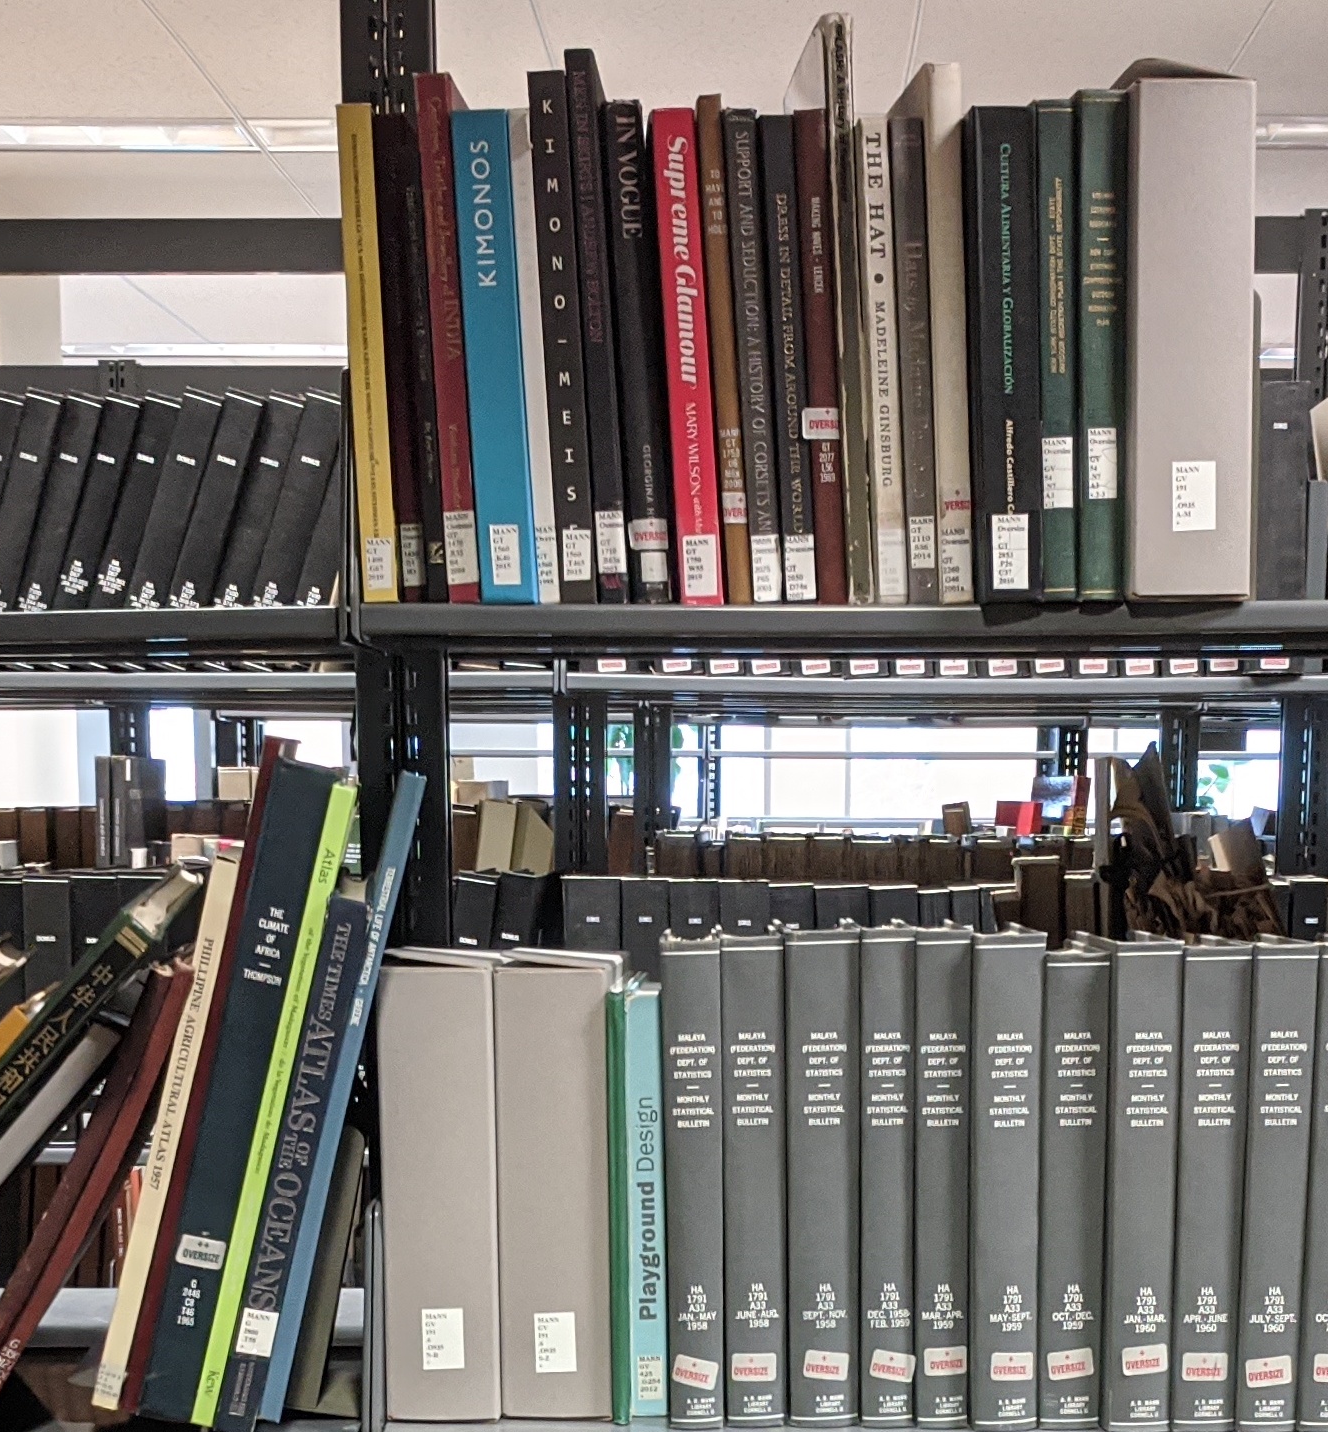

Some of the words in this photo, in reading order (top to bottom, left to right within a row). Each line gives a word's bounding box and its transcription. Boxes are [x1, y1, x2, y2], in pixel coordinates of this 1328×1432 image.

[616, 114, 637, 144] IN
[735, 129, 753, 205] SUPPORT
[865, 132, 882, 190] THE
[616, 147, 644, 240] VOGUE
[666, 135, 690, 262] Supreme
[470, 139, 497, 288] KIMONOS
[741, 207, 755, 236] AND
[868, 203, 886, 259] HAT
[675, 263, 699, 390] Glamour
[874, 300, 891, 399] MADELEINE
[685, 402, 697, 438] MARY
[879, 401, 894, 488] GINSBURG
[686, 438, 703, 496] WILSON
[1176, 465, 1200, 474] MANN
[318, 847, 336, 885] Atlas
[259, 917, 290, 935] CLIMATE
[270, 905, 285, 921] THE
[254, 944, 281, 960] AFRICA
[265, 933, 277, 944] OF
[330, 922, 352, 959] THE
[243, 968, 283, 987] THOMPSON
[316, 960, 341, 1020] TIMES
[678, 1033, 706, 1042] MALAYA
[162, 1014, 196, 1115] AGRICULTURAL
[287, 1012, 335, 1133] ATLAS
[673, 1070, 712, 1080] STATISTICS
[672, 1106, 715, 1117] STATISTICAL
[677, 1094, 710, 1104] MONTHLY
[154, 1115, 175, 1165] ATLAS
[635, 1096, 658, 1173] Design
[677, 1118, 710, 1129] BULLETIN
[150, 1165, 164, 1193] 1957
[182, 1247, 222, 1264] OVERSIZE
[248, 1171, 303, 1312] OCEANS
[636, 1181, 661, 1321] Playground
[686, 1294, 707, 1304] 1791
[815, 1291, 836, 1301] 1791
[686, 1320, 708, 1331] 1958
[674, 1366, 710, 1384] OVERSIZE
[805, 1363, 840, 1376] OVERSIZE
